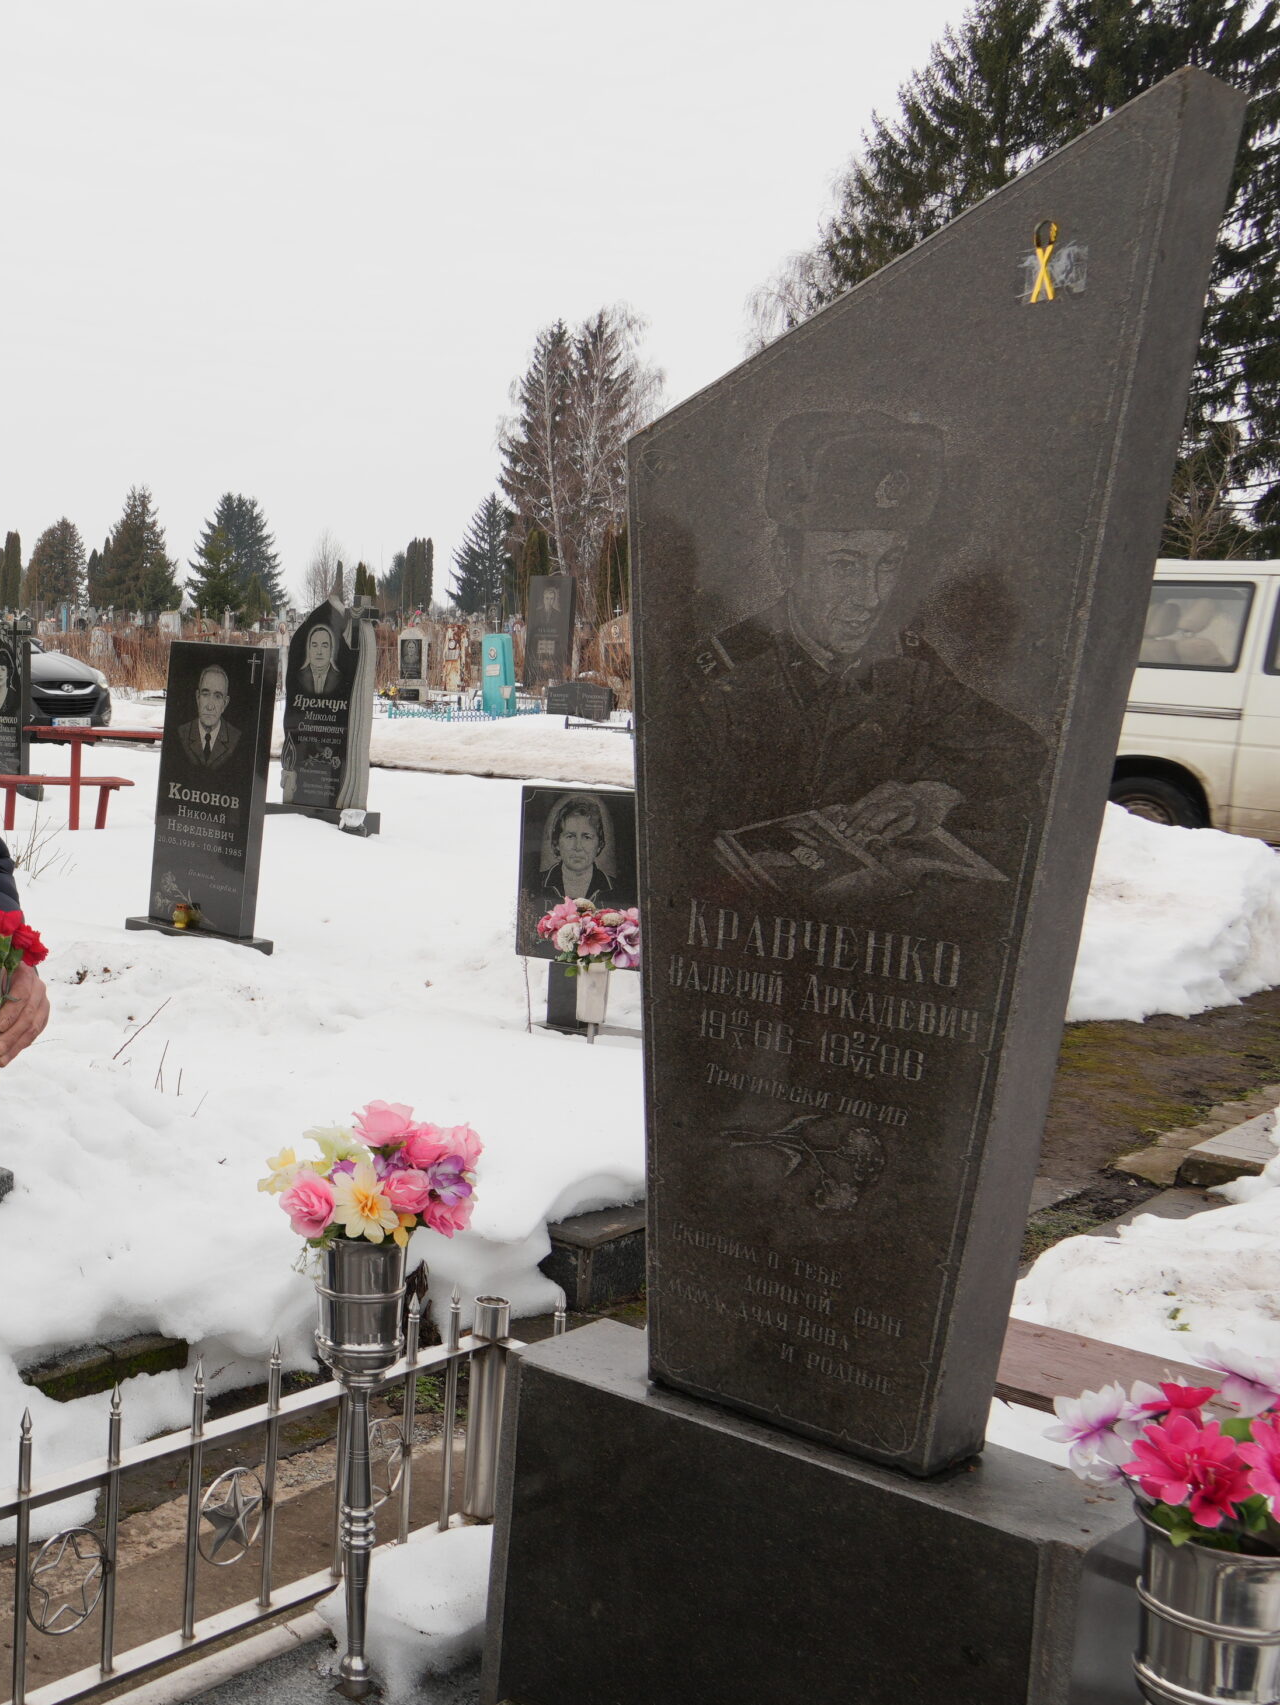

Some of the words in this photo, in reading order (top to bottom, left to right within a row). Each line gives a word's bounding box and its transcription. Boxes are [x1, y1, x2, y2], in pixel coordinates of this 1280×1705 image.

[293, 694, 348, 713] Яремчук
[304, 711, 337, 722] Микола
[298, 722, 344, 734] Степанович
